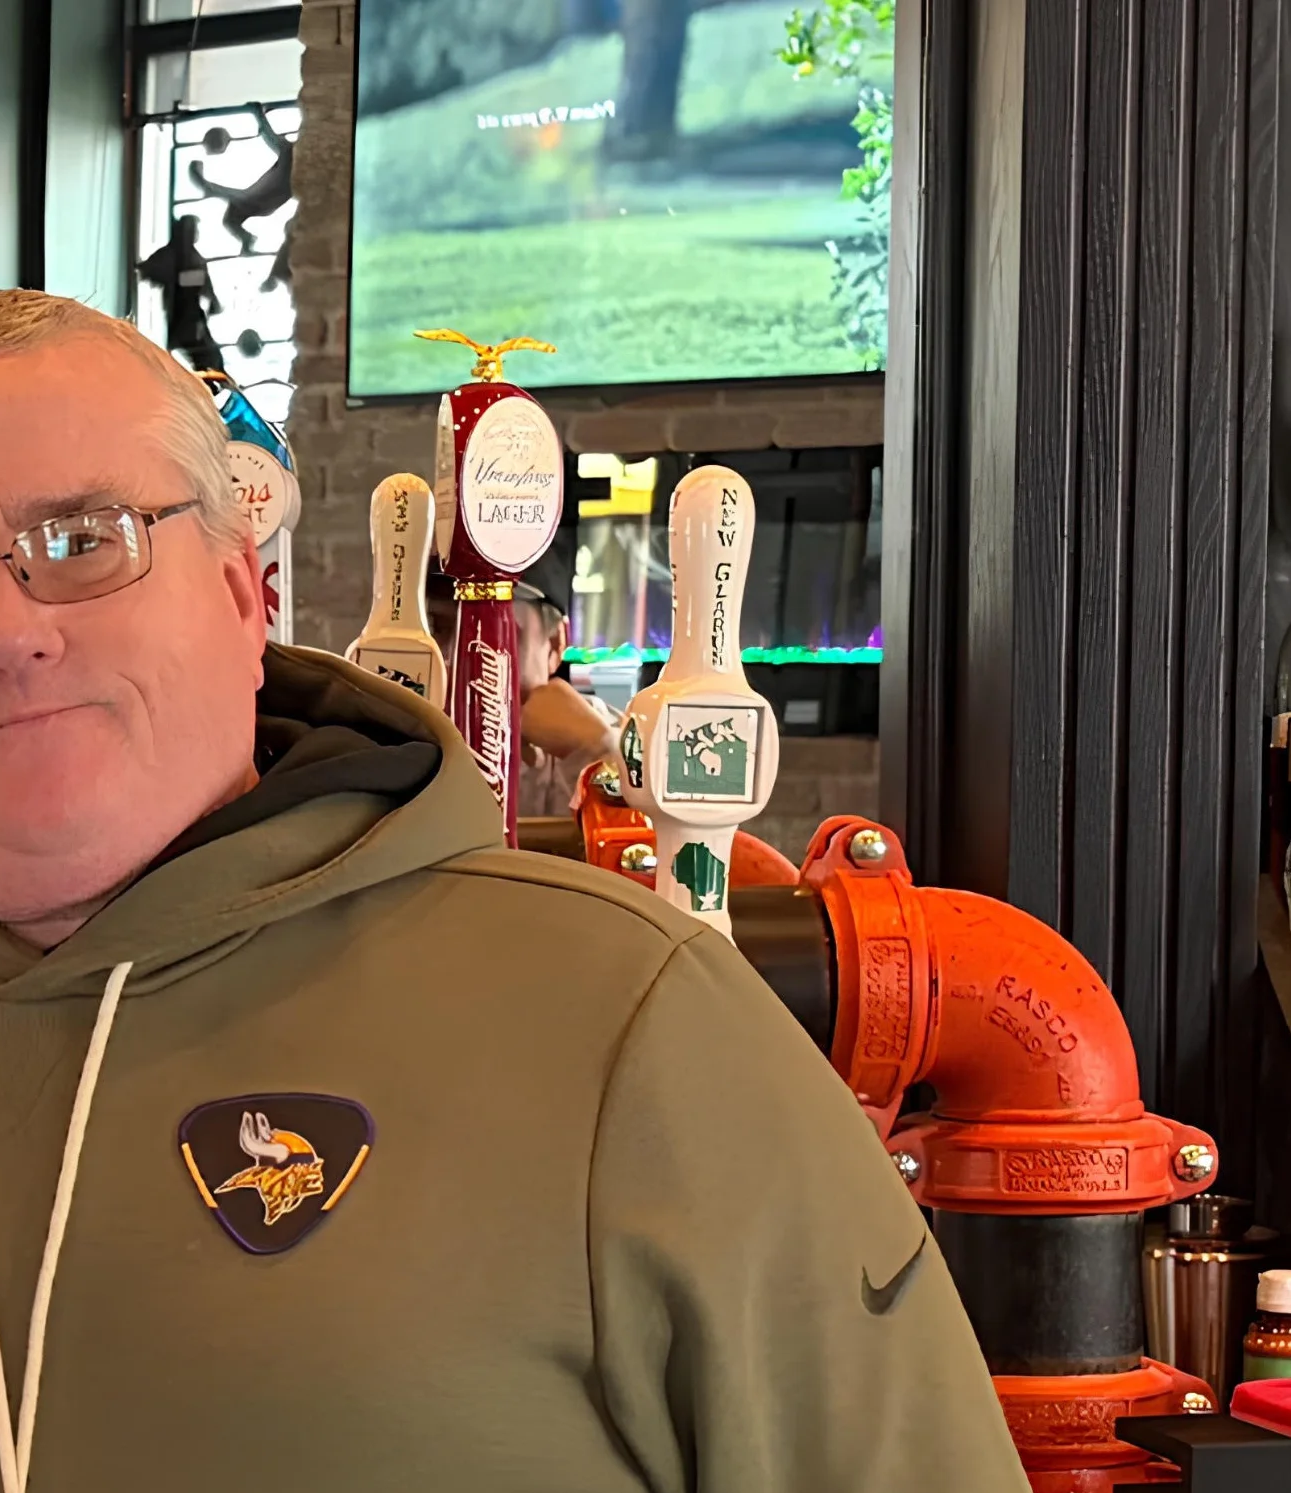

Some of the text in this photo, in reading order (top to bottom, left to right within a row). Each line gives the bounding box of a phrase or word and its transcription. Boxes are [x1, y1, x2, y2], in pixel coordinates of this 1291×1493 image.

[478, 502, 545, 524] LAGER
[717, 488, 738, 547] NEW
[996, 975, 1078, 1053] RASCO
